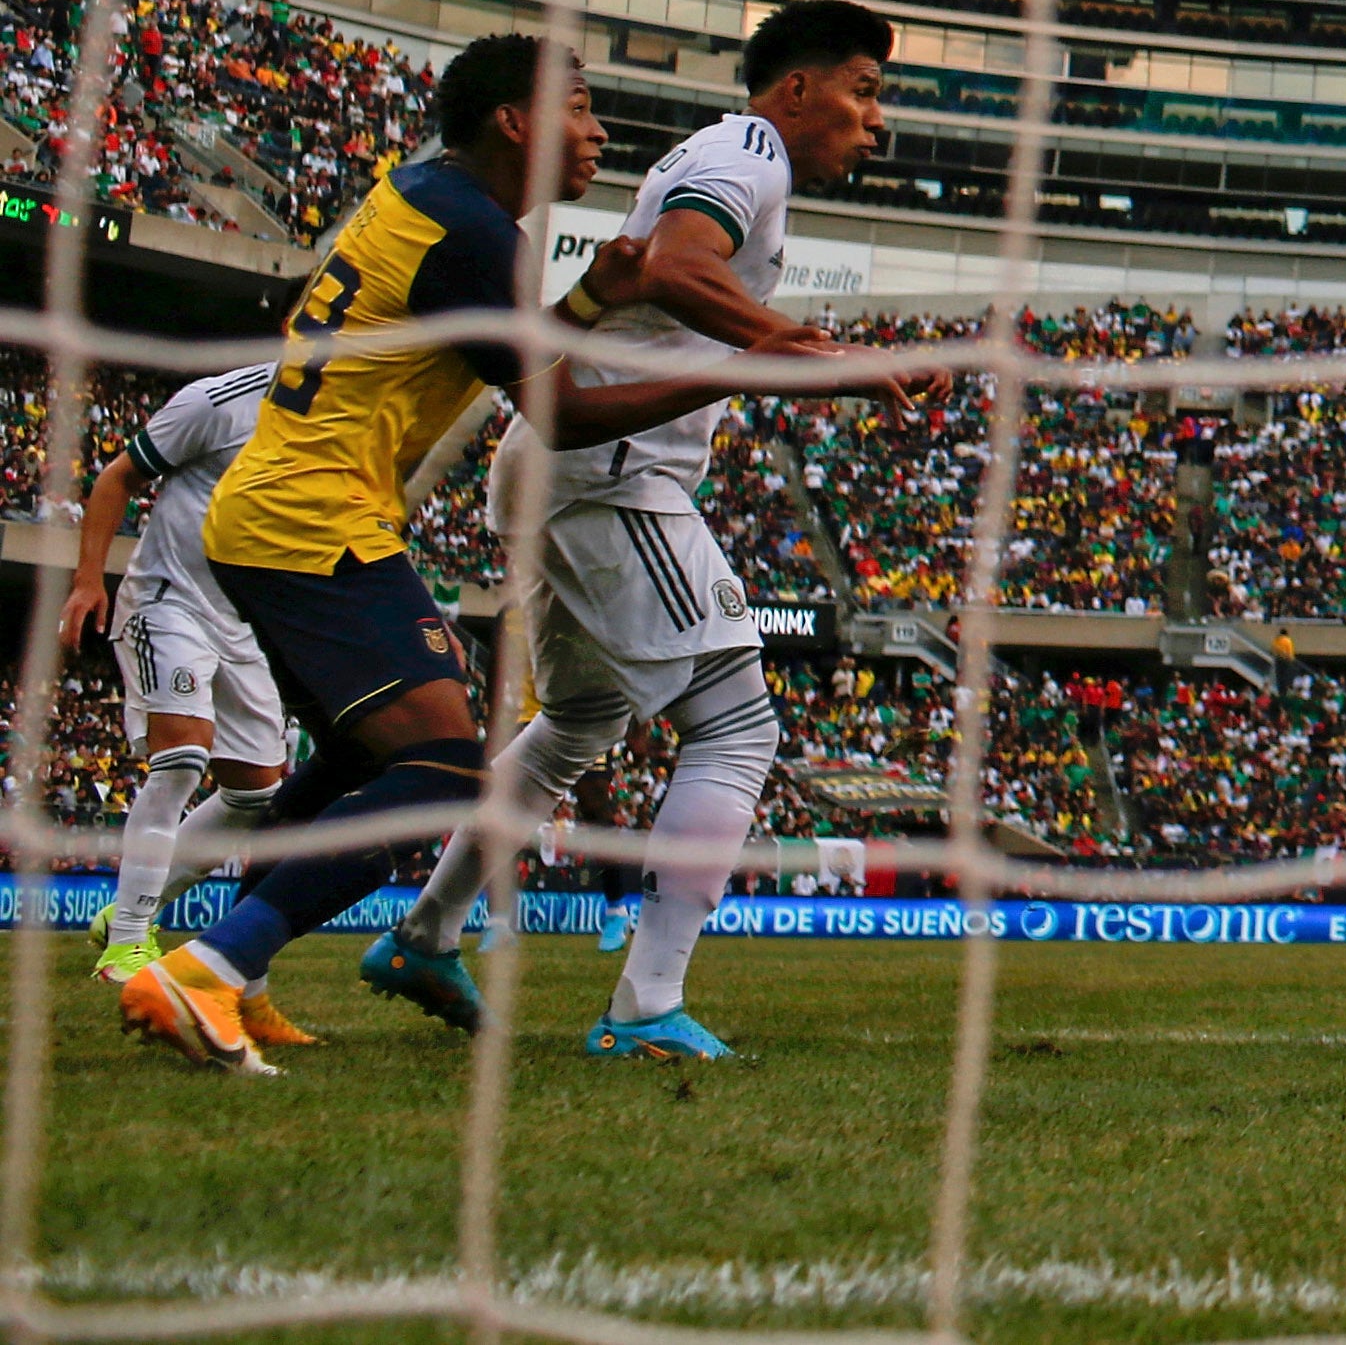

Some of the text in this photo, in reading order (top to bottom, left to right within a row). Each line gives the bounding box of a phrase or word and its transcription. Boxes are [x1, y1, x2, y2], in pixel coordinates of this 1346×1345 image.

[812, 266, 863, 294] suite
[774, 907, 813, 934] DE
[824, 908, 879, 935] TUS
[882, 901, 1008, 937] SUEÑOS
